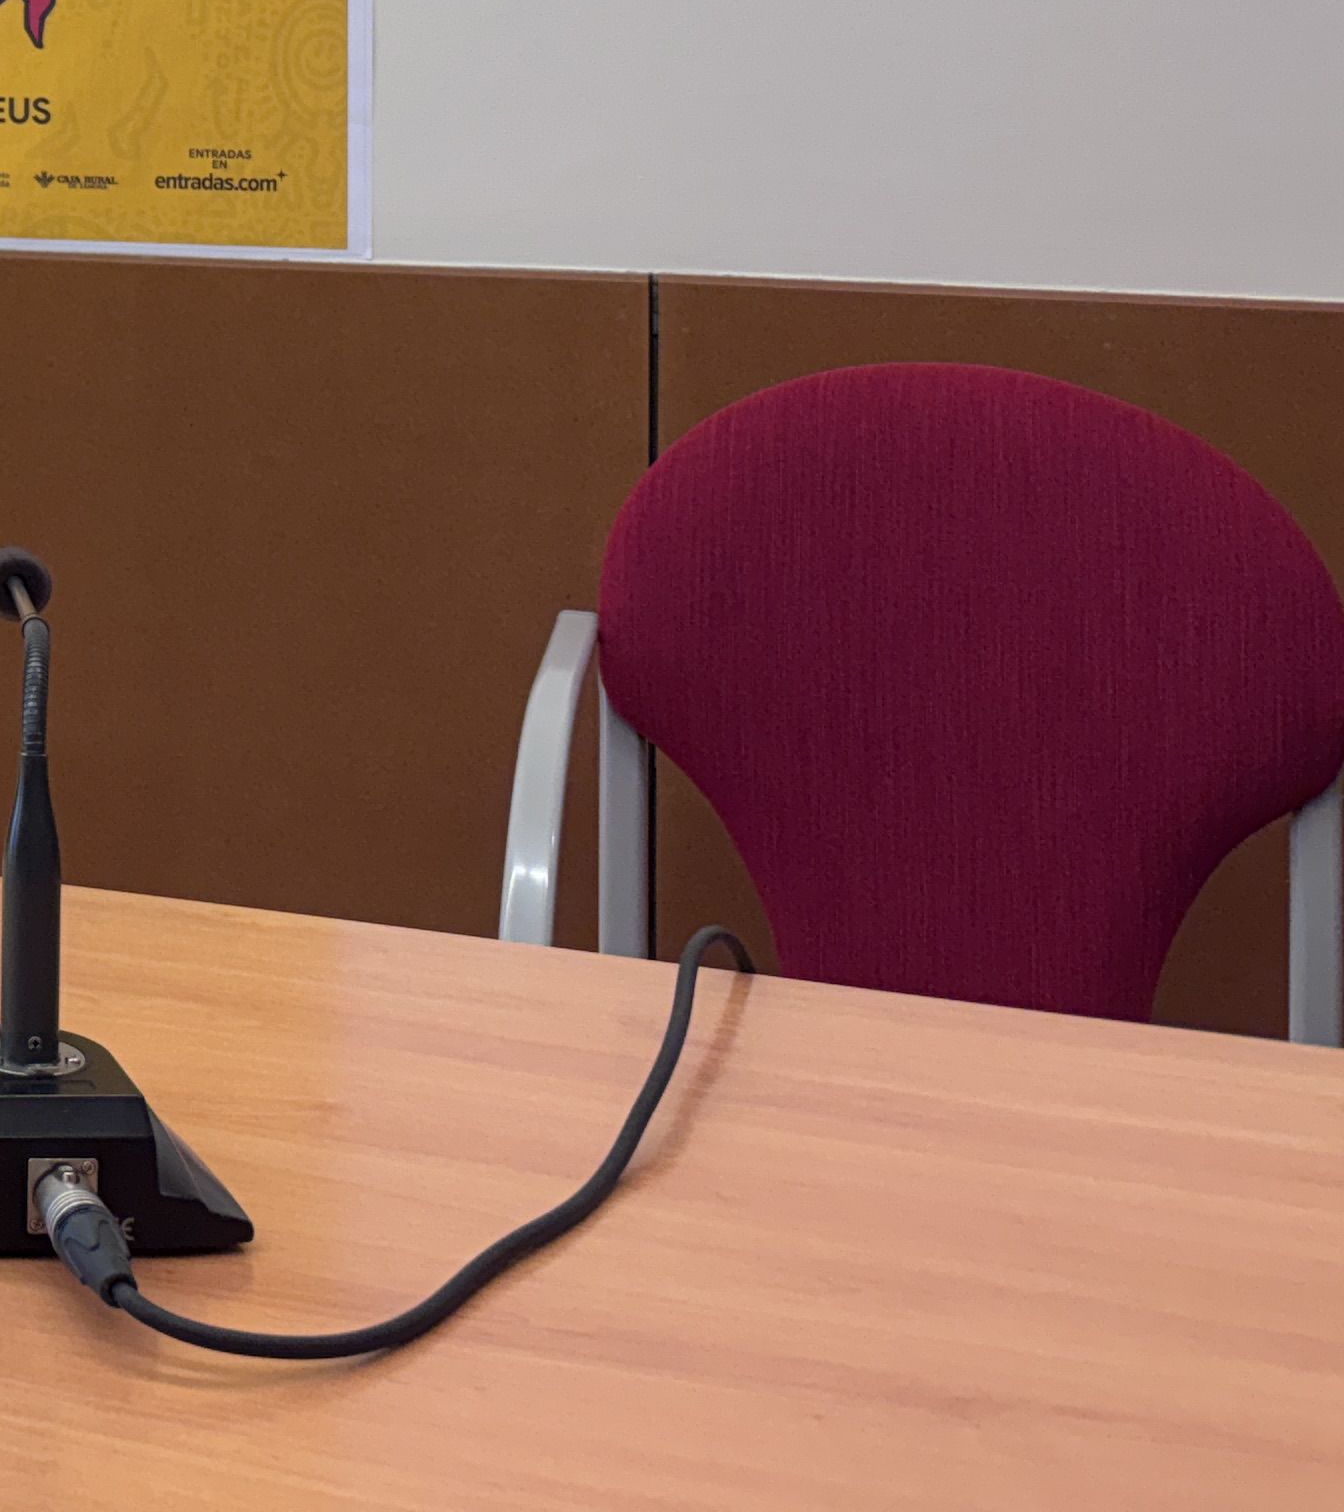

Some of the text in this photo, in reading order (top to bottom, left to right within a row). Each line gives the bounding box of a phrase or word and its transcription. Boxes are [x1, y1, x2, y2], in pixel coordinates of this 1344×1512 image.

[188, 148, 252, 160] ENTRADAS
[212, 159, 228, 170] EN
[154, 173, 278, 193] entradas.com
